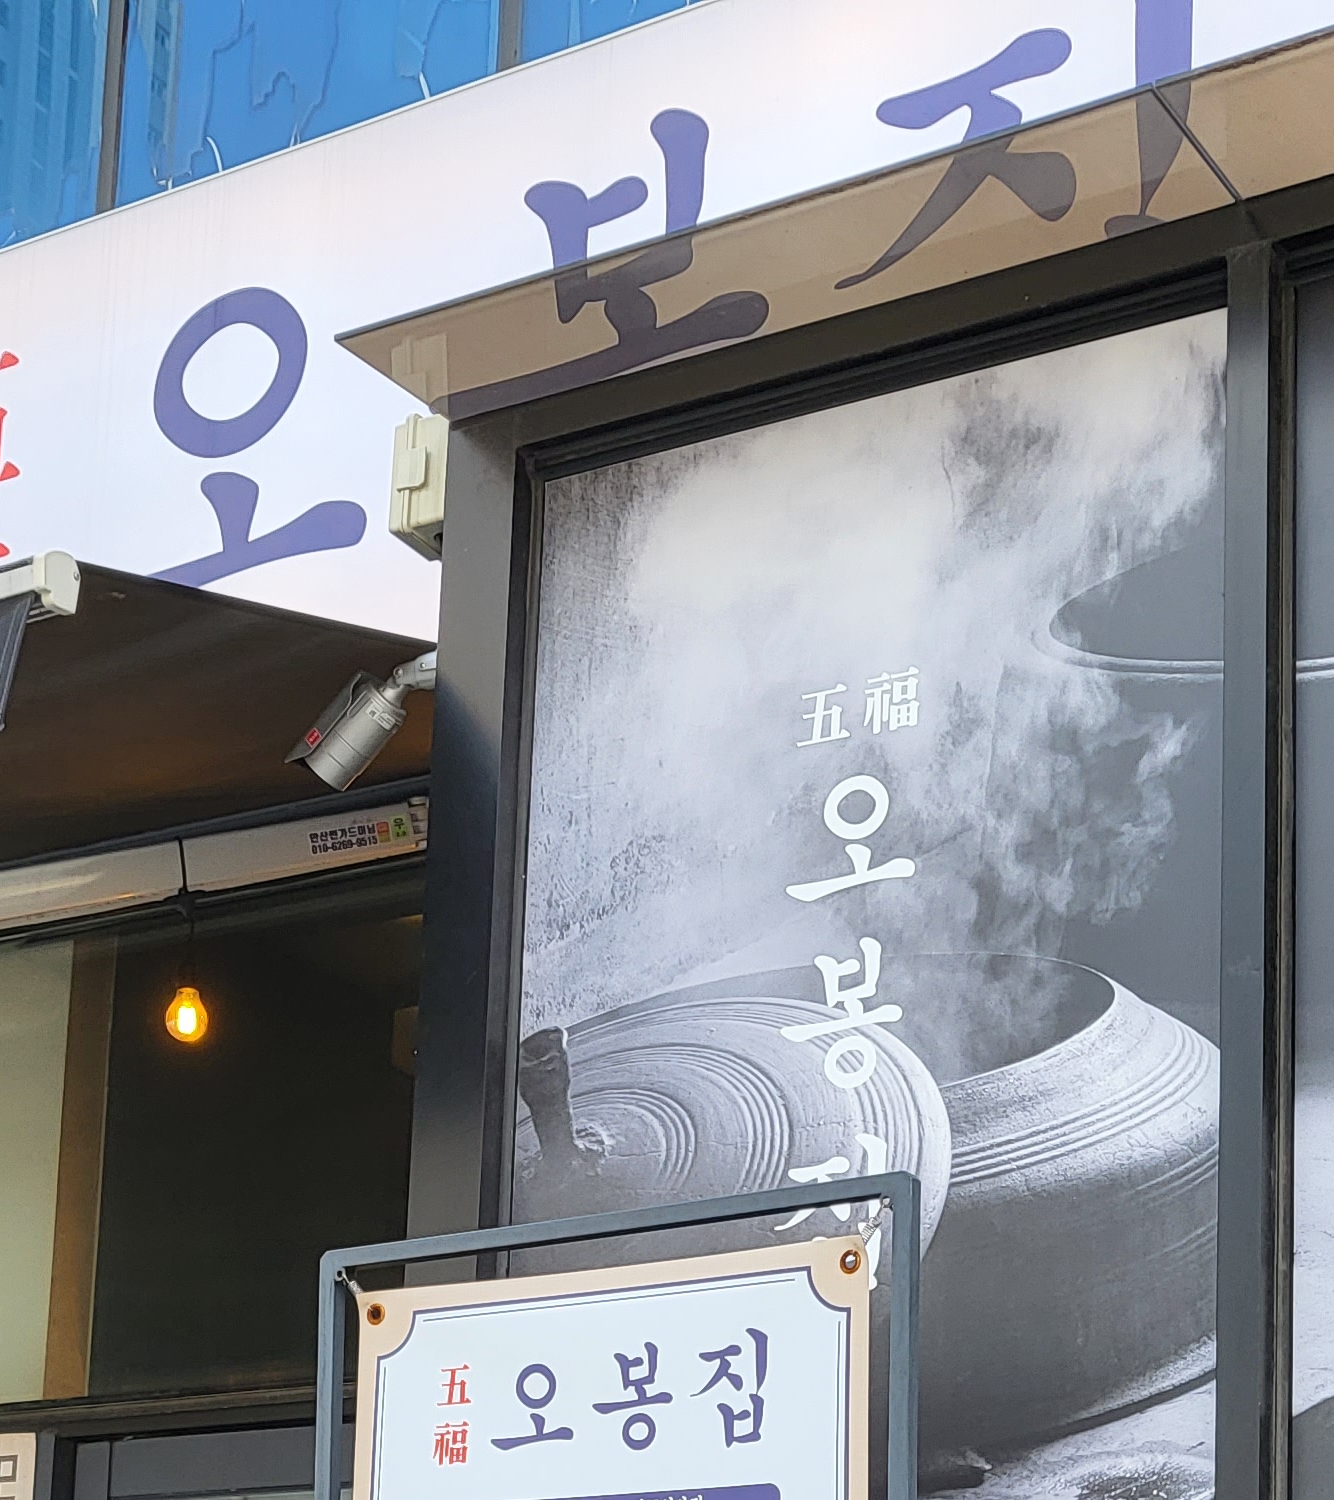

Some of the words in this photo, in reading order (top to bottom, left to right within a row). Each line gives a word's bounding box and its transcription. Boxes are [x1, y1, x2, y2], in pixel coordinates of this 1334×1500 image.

[795, 666, 921, 749] 五福
[432, 1363, 472, 1467] 五福
[490, 1327, 769, 1451] 오봉집
